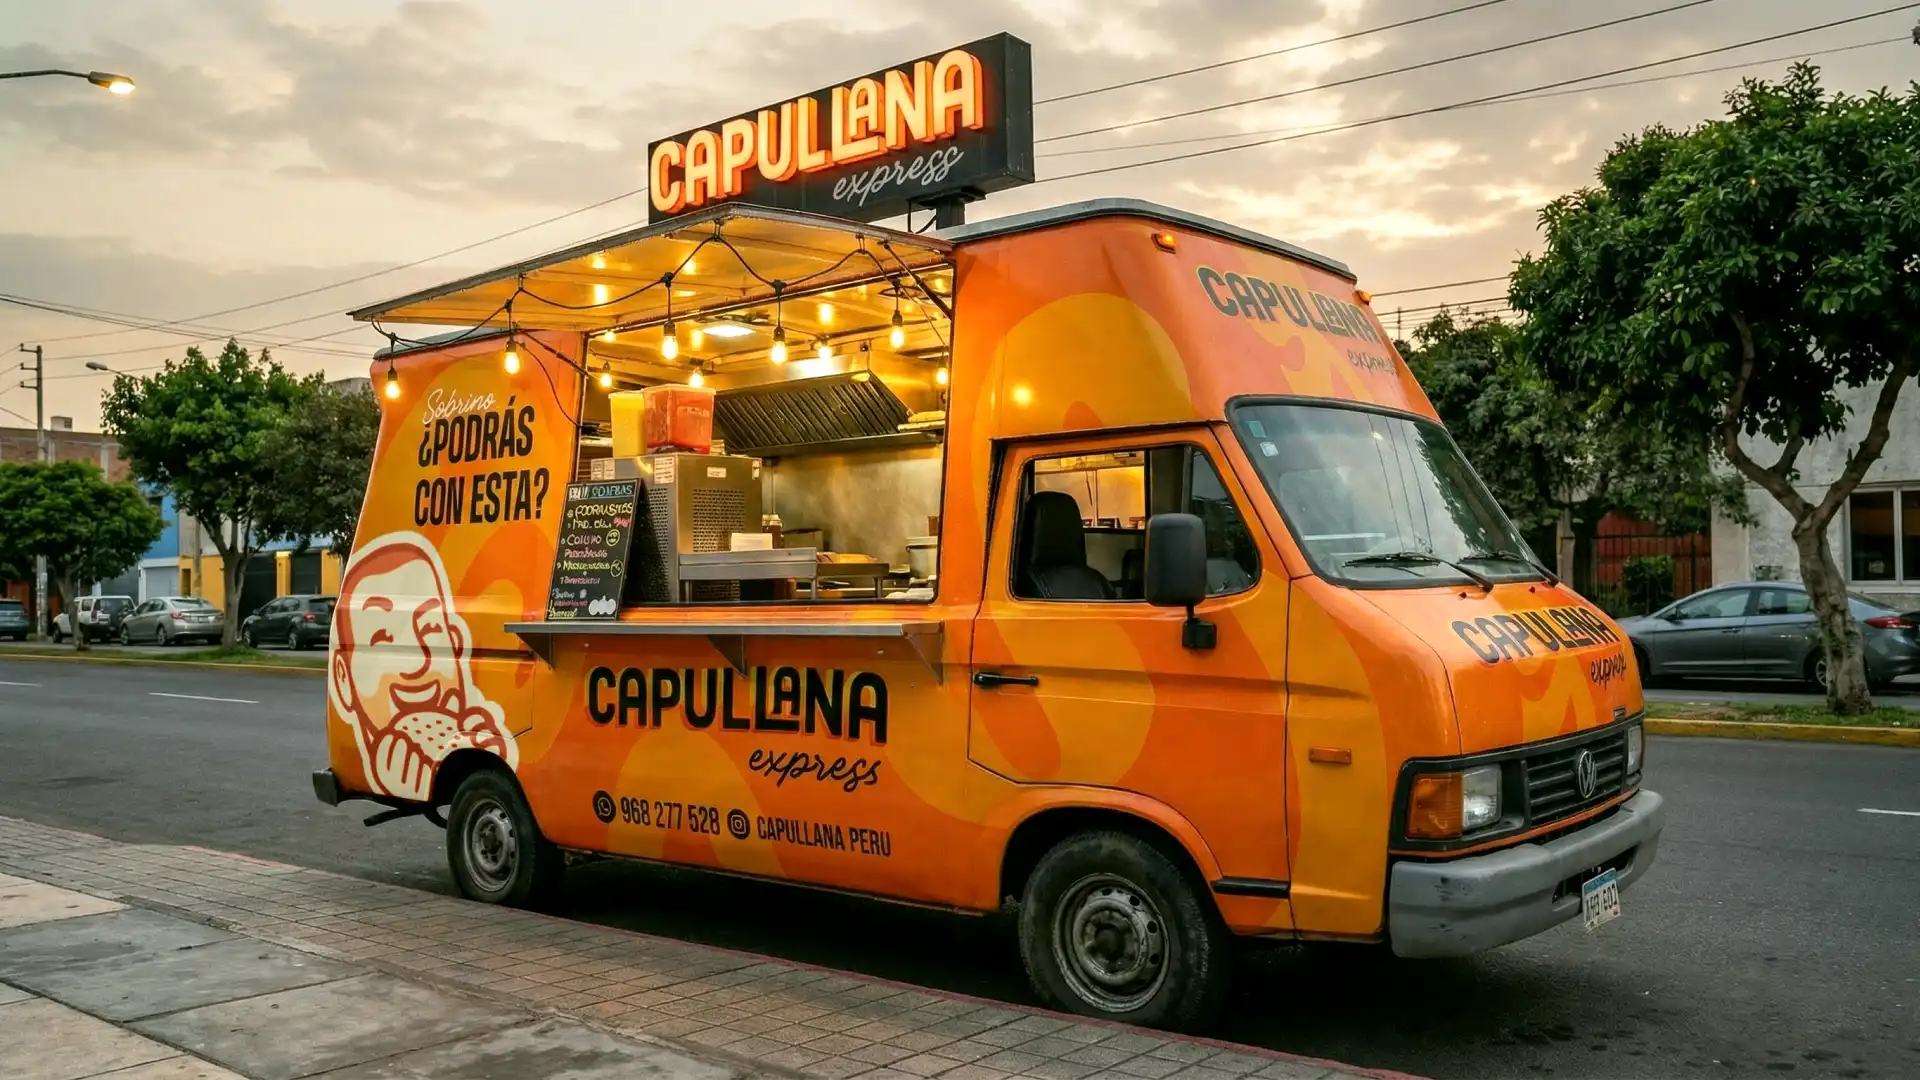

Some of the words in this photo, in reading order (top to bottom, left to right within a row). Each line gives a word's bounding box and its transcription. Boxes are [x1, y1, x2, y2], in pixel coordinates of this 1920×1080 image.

[650, 49, 983, 213] CAPULLANA
[833, 146, 964, 206] express
[1197, 266, 1381, 344] CAPULLANA
[418, 395, 535, 467] ¿PODRÁS
[422, 388, 496, 424] Sobrino
[414, 475, 465, 527] CON
[469, 467, 550, 524] ESTA?
[1451, 606, 1621, 664] CAPULLANA
[587, 665, 889, 745] CAPULLANA
[749, 748, 882, 793] express
[620, 796, 651, 826] 968
[654, 801, 683, 830] 277
[687, 804, 720, 835] 528
[756, 814, 846, 851] CAPULLANA
[848, 826, 891, 857] PERU
